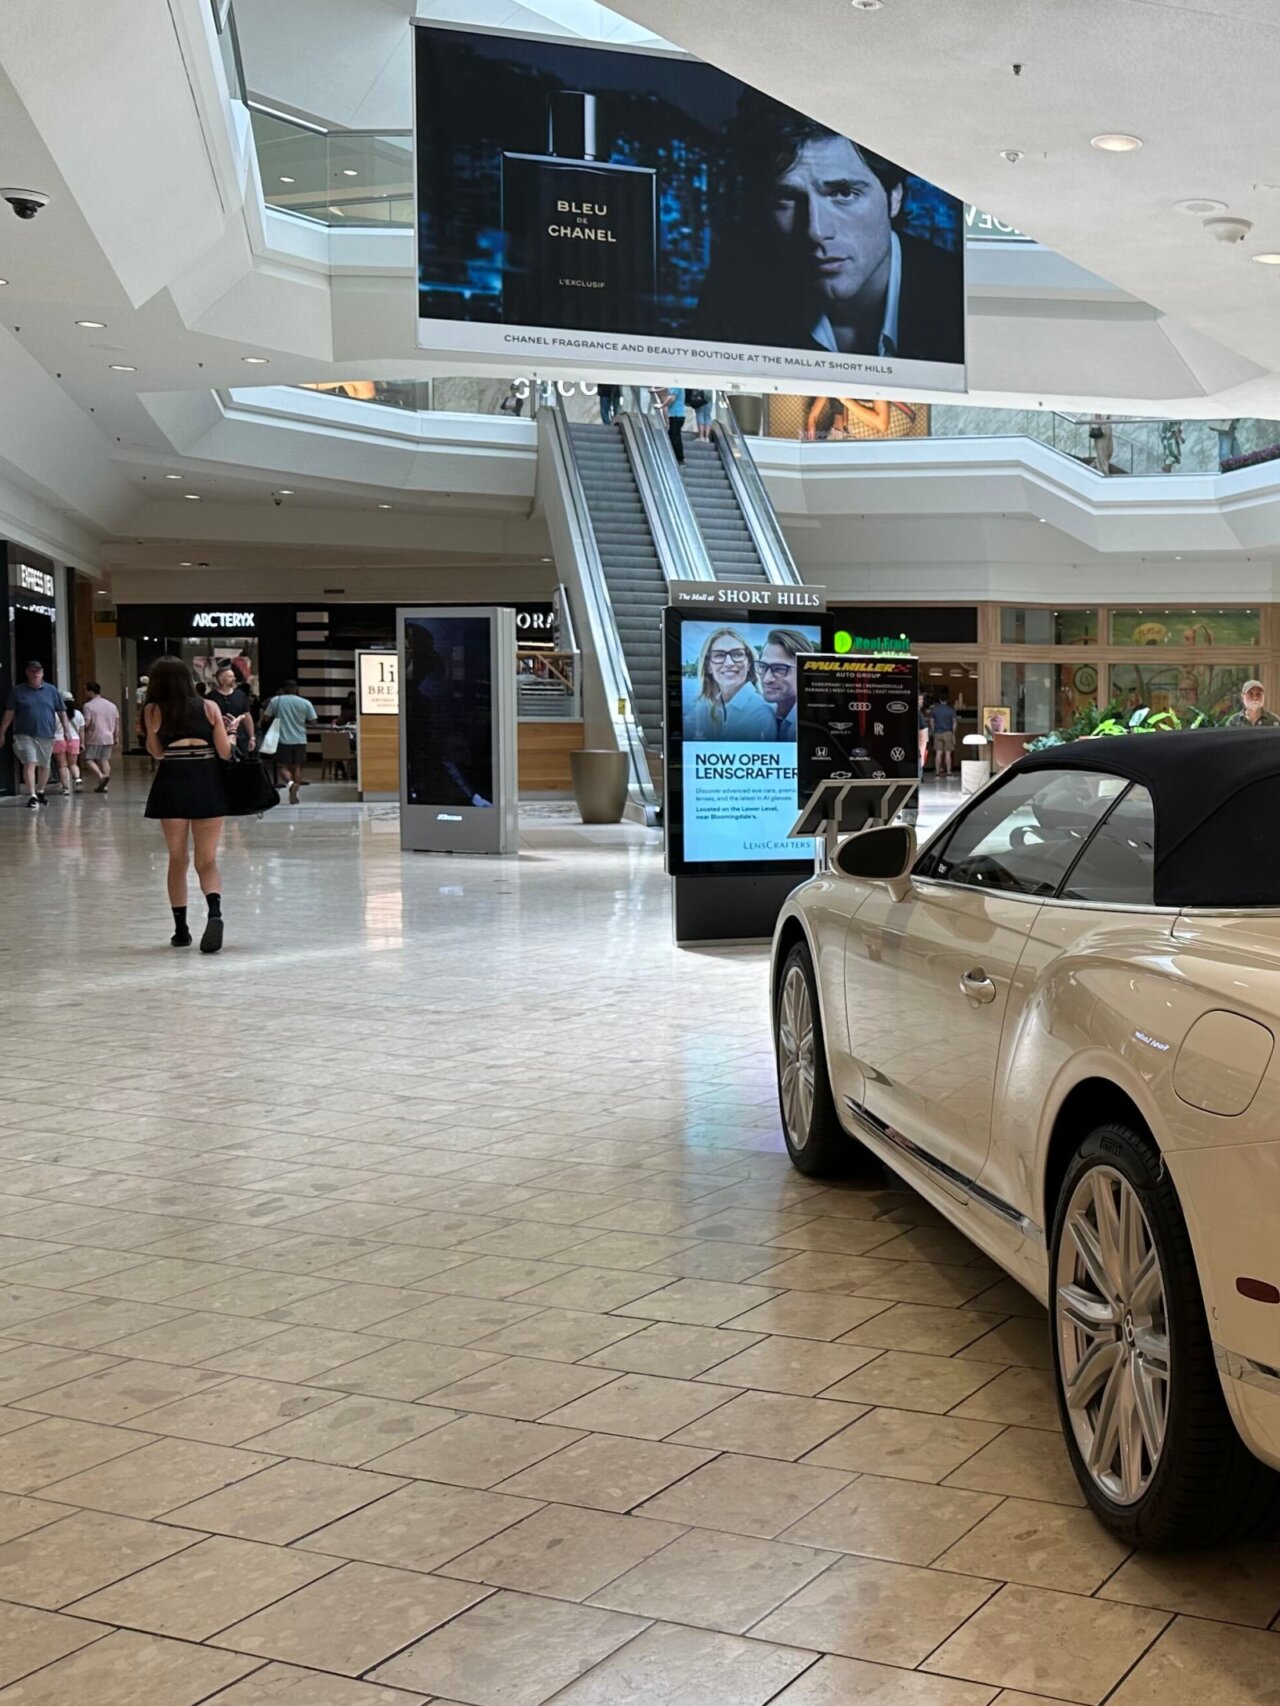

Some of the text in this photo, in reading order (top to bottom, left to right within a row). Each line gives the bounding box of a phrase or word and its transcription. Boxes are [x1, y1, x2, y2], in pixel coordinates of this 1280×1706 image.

[557, 200, 607, 215] BLEU
[548, 225, 617, 242] CHANEL
[559, 279, 605, 288] L'EXCLUSIF
[504, 334, 893, 374] CHANEL FRAGRANCE AND BEAUTY BOUTIQUE AT THE MALL AT SHORT HILLS
[678, 592, 691, 600] The
[691, 593, 707, 601] Mall
[718, 589, 772, 604] SHORT
[777, 592, 820, 606] HILLS
[695, 754, 780, 766] NOW OPEN
[695, 767, 798, 779] LENSCRAFTER
